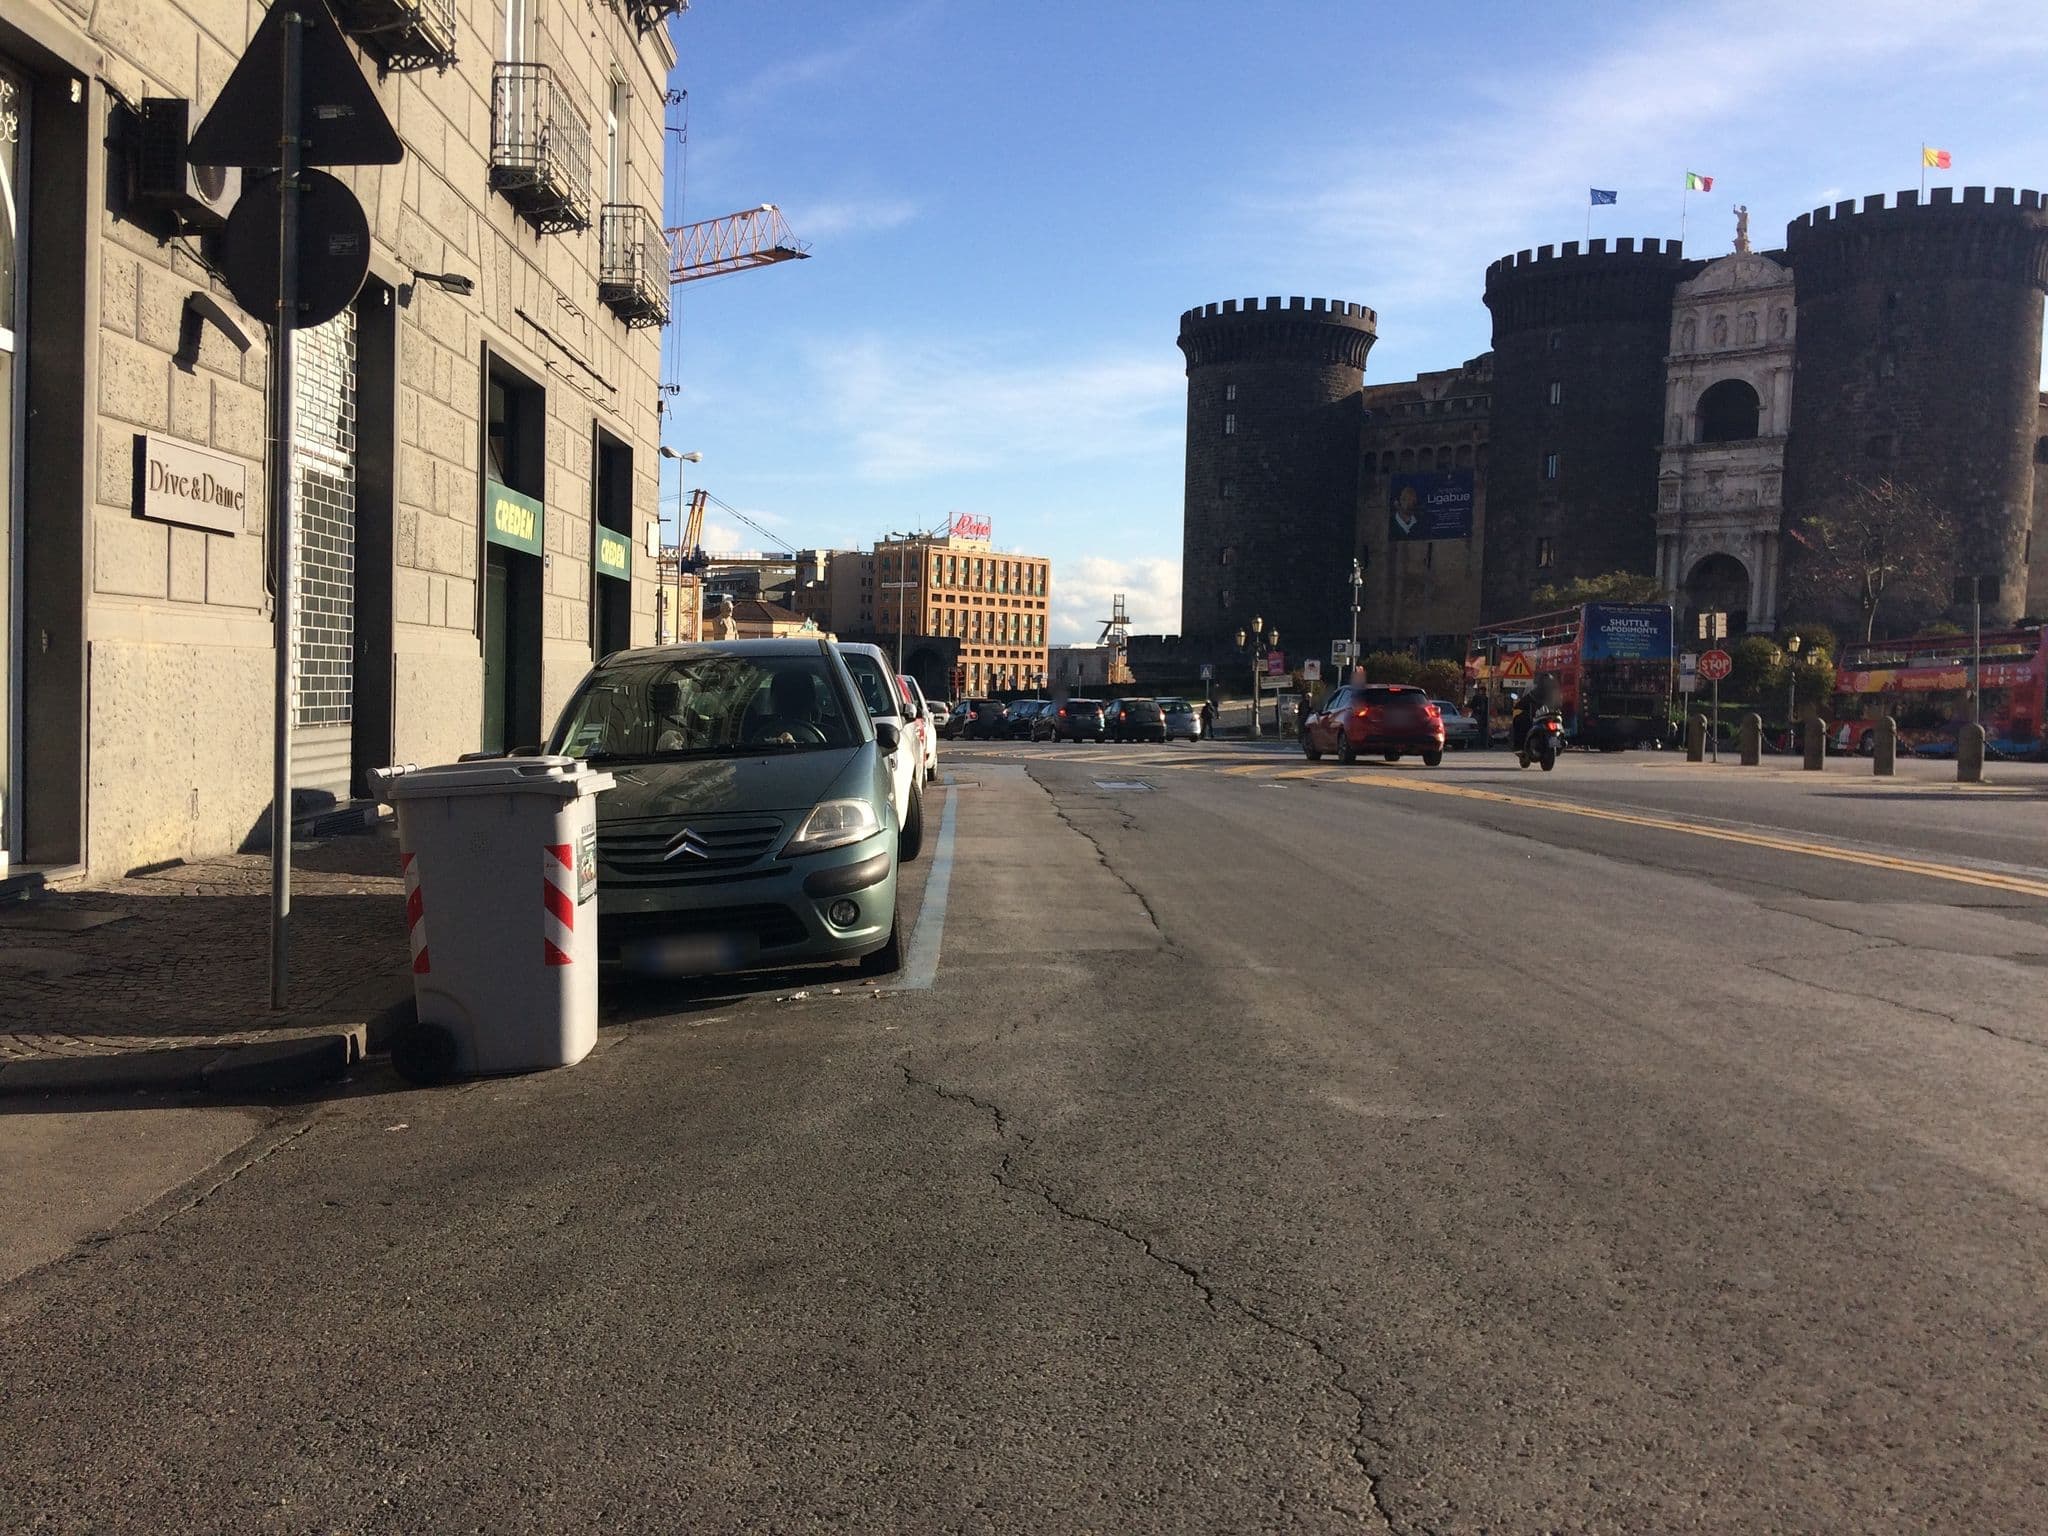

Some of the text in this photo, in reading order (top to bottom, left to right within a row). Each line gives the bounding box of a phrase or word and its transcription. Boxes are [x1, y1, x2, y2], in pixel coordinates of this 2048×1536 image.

[1427, 492, 1470, 504] Ligabue
[495, 499, 536, 541] CREDEM
[602, 538, 626, 569] CREDEM
[1609, 618, 1650, 627] SHUTTLE
[1600, 625, 1658, 634] CAPODIMONTE
[1701, 659, 1730, 673] STOP
